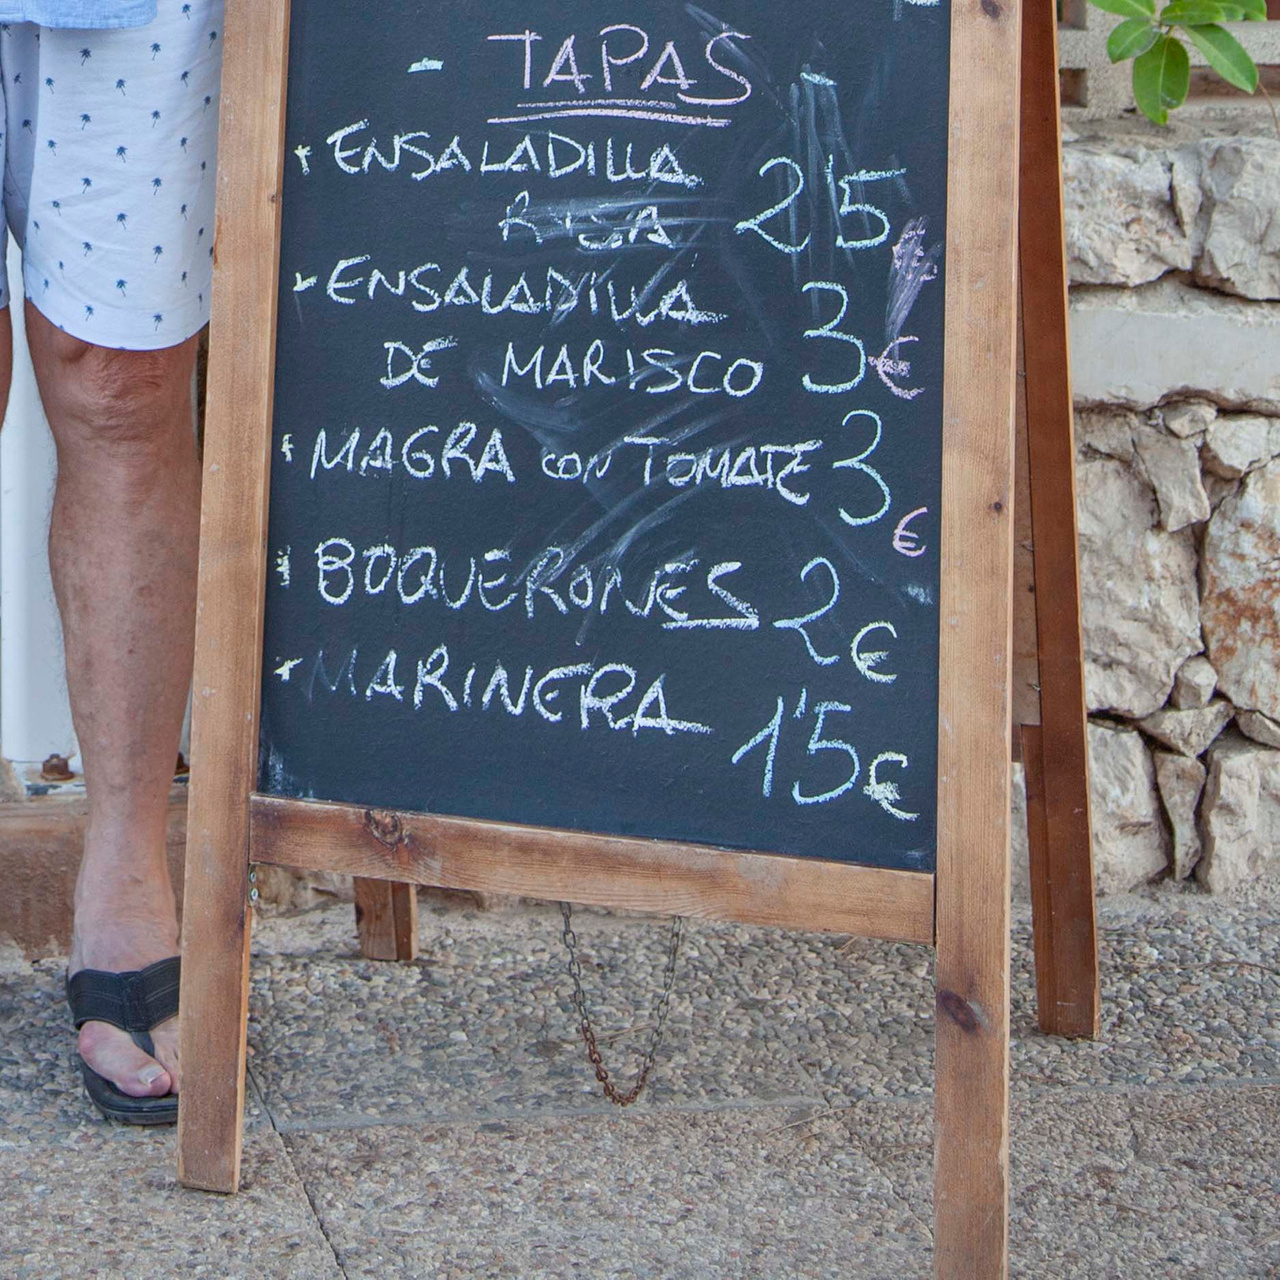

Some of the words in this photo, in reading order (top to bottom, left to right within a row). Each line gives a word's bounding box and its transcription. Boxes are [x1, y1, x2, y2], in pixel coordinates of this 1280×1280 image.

[487, 22, 752, 104] TAPAS
[326, 118, 704, 188] ENSALADILLA
[326, 254, 728, 327] ENSALADILLA
[380, 337, 458, 389] DE
[501, 340, 763, 397] MARISCO
[310, 421, 516, 484] MAGRA
[624, 435, 823, 506] TOMATE
[315, 537, 759, 630] BOQUERONES
[310, 643, 715, 735] MARINERA
